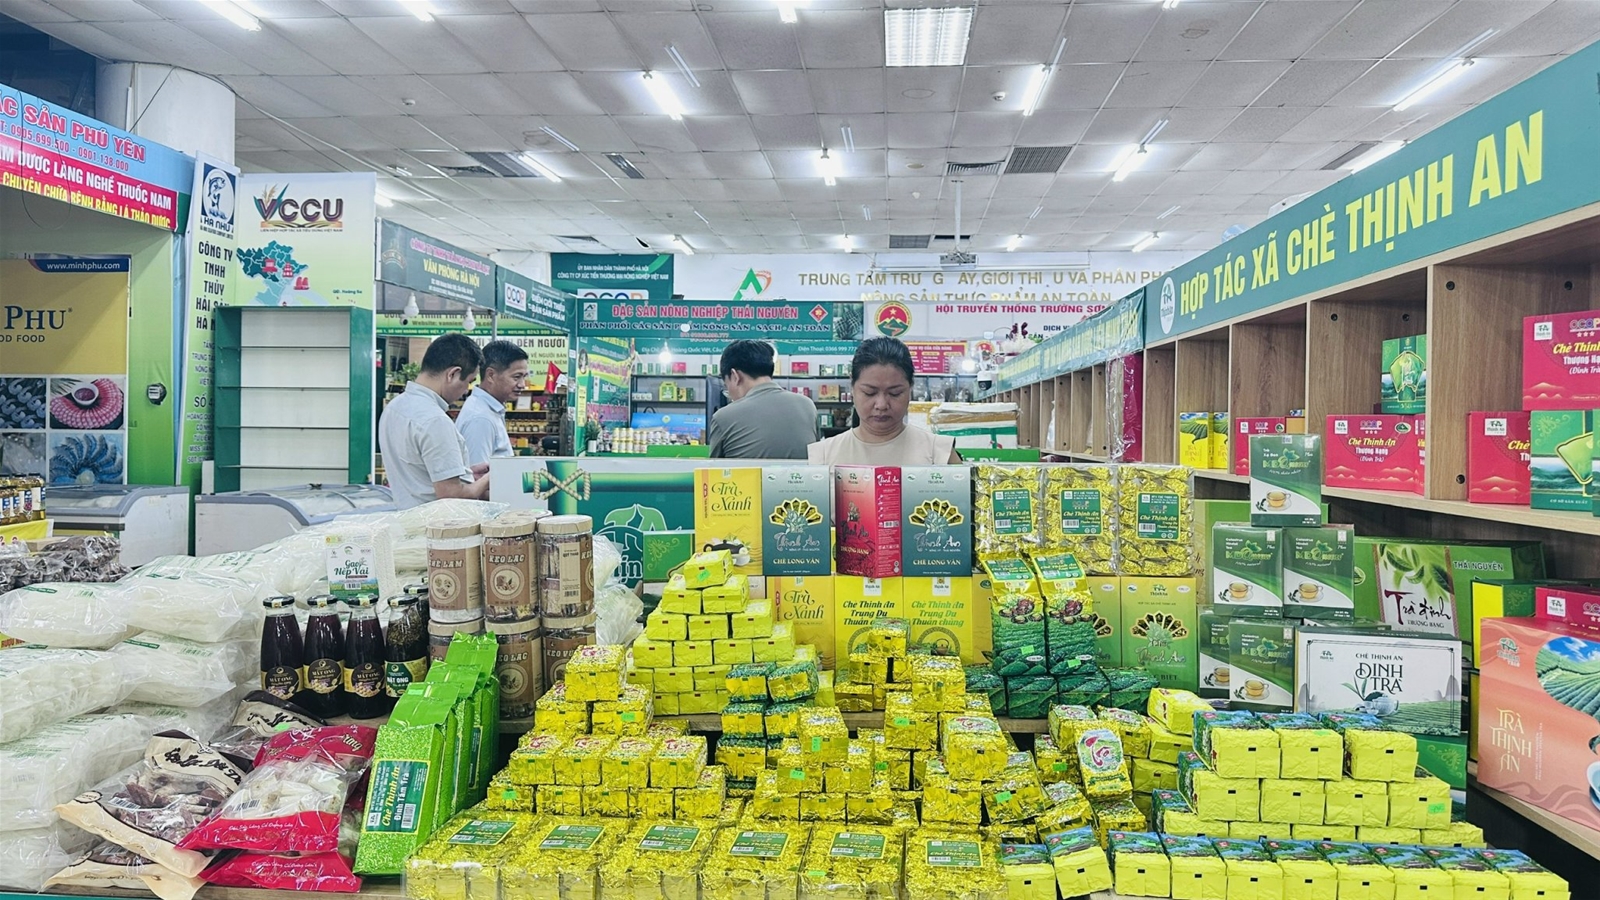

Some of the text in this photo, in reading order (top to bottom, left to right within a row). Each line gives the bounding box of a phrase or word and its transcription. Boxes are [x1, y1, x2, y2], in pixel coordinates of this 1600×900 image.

[24, 104, 67, 136] SẢN
[72, 119, 109, 150] PHÚ
[113, 134, 146, 163] YÊN
[54, 160, 84, 184] LÀNG
[117, 183, 148, 204] THUỐC
[150, 191, 171, 210] NAM
[255, 195, 353, 223] VCCU
[1180, 108, 1544, 321] HỢP TÁC XÃ CHÈ THỊNH AN
[199, 241, 233, 262] CÔNG TY
[46, 261, 121, 272] www.minhphu.com
[204, 261, 226, 280] TNHH
[423, 258, 437, 275] VĂN
[438, 264, 460, 282] PHÒNG
[460, 269, 469, 284] HÀ
[799, 273, 851, 286] TRUNG
[1092, 267, 1136, 286] PHÂN
[611, 299, 799, 321] ĐẶC SẢN NÔNG NGHIỆP THÁI NGUYÊN
[936, 303, 954, 315] HỘI
[957, 303, 999, 314] TRUYỀN
[1001, 302, 1037, 314] THỐNG
[1040, 302, 1083, 314] TRƯỜNG
[632, 321, 651, 332] CÁC
[652, 321, 672, 332] SẢN
[702, 322, 728, 331] NÔNG
[730, 322, 750, 332] SẢN
[756, 323, 782, 333] SẠCH
[787, 323, 802, 333] AN
[16, 334, 46, 343] FOOD
[1552, 342, 1572, 355] Chè
[1563, 355, 1589, 368] Thượng
[194, 392, 206, 408] SỐ
[1348, 436, 1362, 446] Chè
[1363, 437, 1384, 448] Thịnh
[1507, 439, 1530, 452] Chè
[711, 481, 743, 497] Trà
[711, 496, 751, 512] Xanh
[442, 559, 464, 569] LAM
[507, 553, 526, 567] LẠC
[787, 559, 805, 567] LONG
[805, 557, 820, 567] VÂN
[927, 559, 946, 567] LONG
[946, 558, 961, 567] VÂN
[1452, 558, 1504, 574] THÁI NGUYÊN
[783, 588, 815, 605] Trà
[783, 603, 824, 620] Xanh
[842, 600, 857, 609] Chè
[859, 600, 882, 610] Thịnh
[911, 600, 926, 609] Chè
[928, 600, 952, 611] Thịnh
[1384, 589, 1416, 625] Trà
[850, 610, 889, 619] Trung Du
[919, 610, 957, 619] Trung Du
[938, 617, 965, 628] chủng
[397, 676, 410, 684] ONG
[1496, 707, 1525, 735] TRÀ
[1489, 725, 1532, 758] THỊNH
